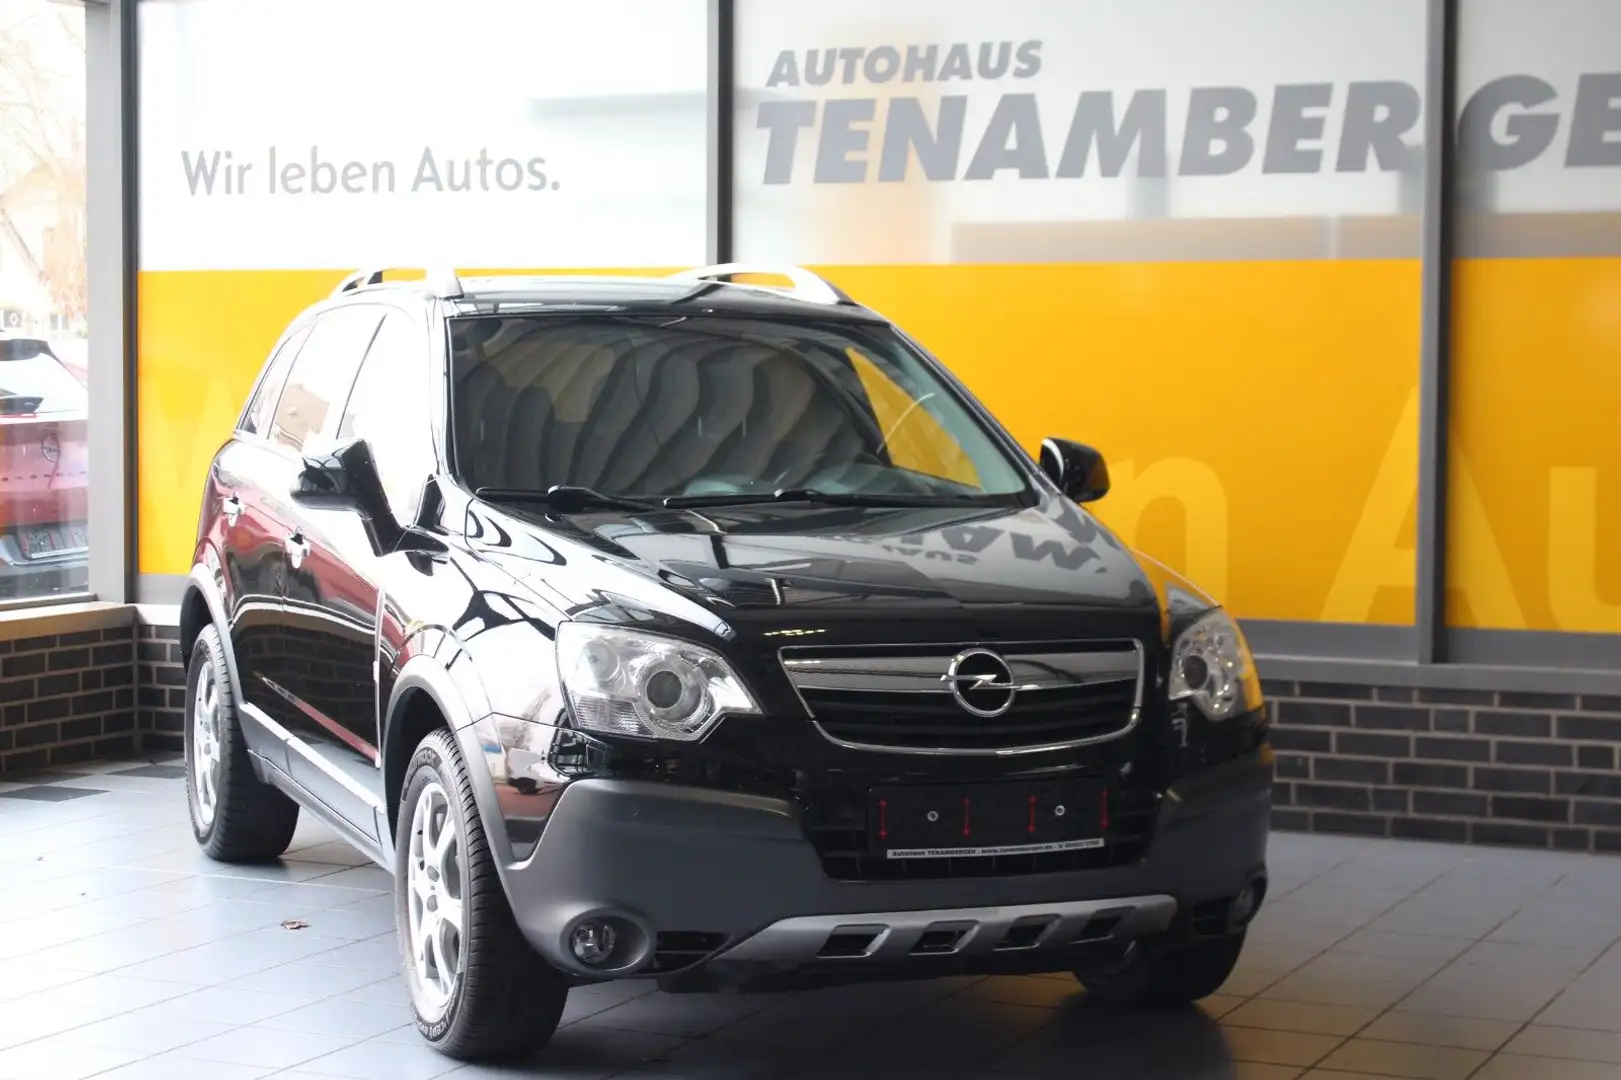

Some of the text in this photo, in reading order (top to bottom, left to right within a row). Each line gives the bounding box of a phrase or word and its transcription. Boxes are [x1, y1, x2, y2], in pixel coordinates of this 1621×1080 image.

[767, 40, 1041, 87] AUTOHAUS
[181, 145, 561, 196] Wir leben Autos.
